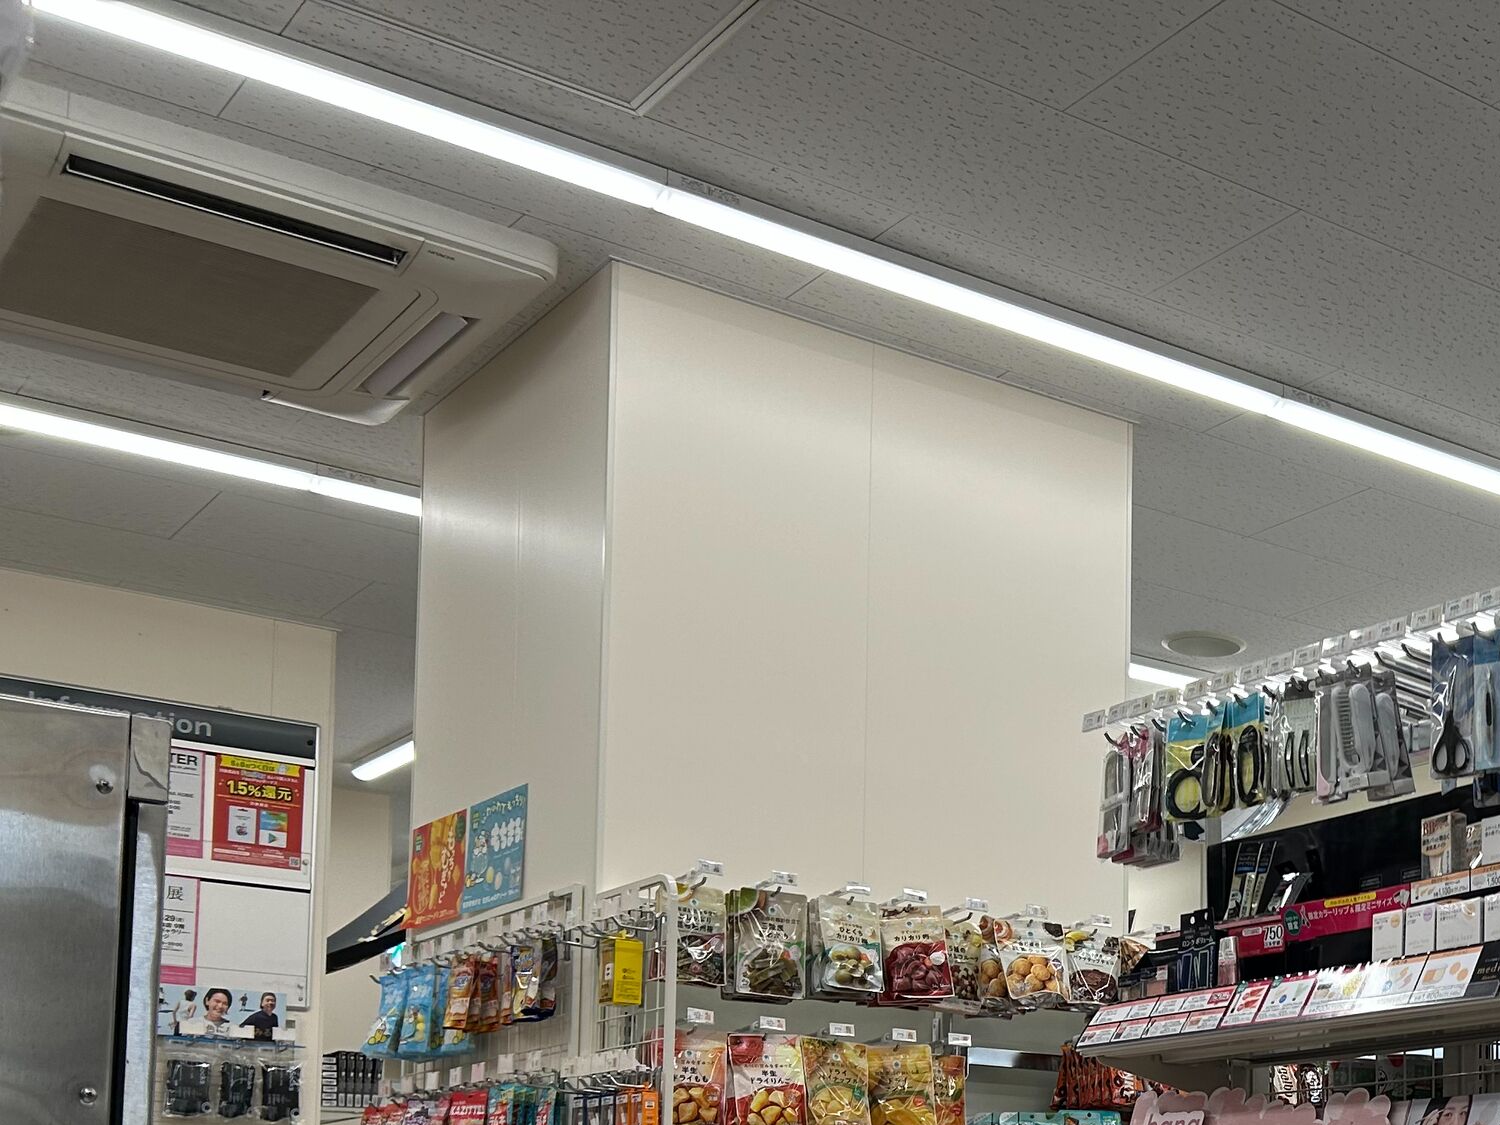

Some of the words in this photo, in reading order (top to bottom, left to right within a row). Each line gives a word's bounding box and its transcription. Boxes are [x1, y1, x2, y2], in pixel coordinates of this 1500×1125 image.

[166, 885, 183, 901] 展
[839, 927, 863, 936] ひとくち
[1263, 925, 1283, 940] 750
[682, 1066, 698, 1074] 半生
[761, 1070, 778, 1078] 半生
[750, 1077, 791, 1085] ドライりんご
